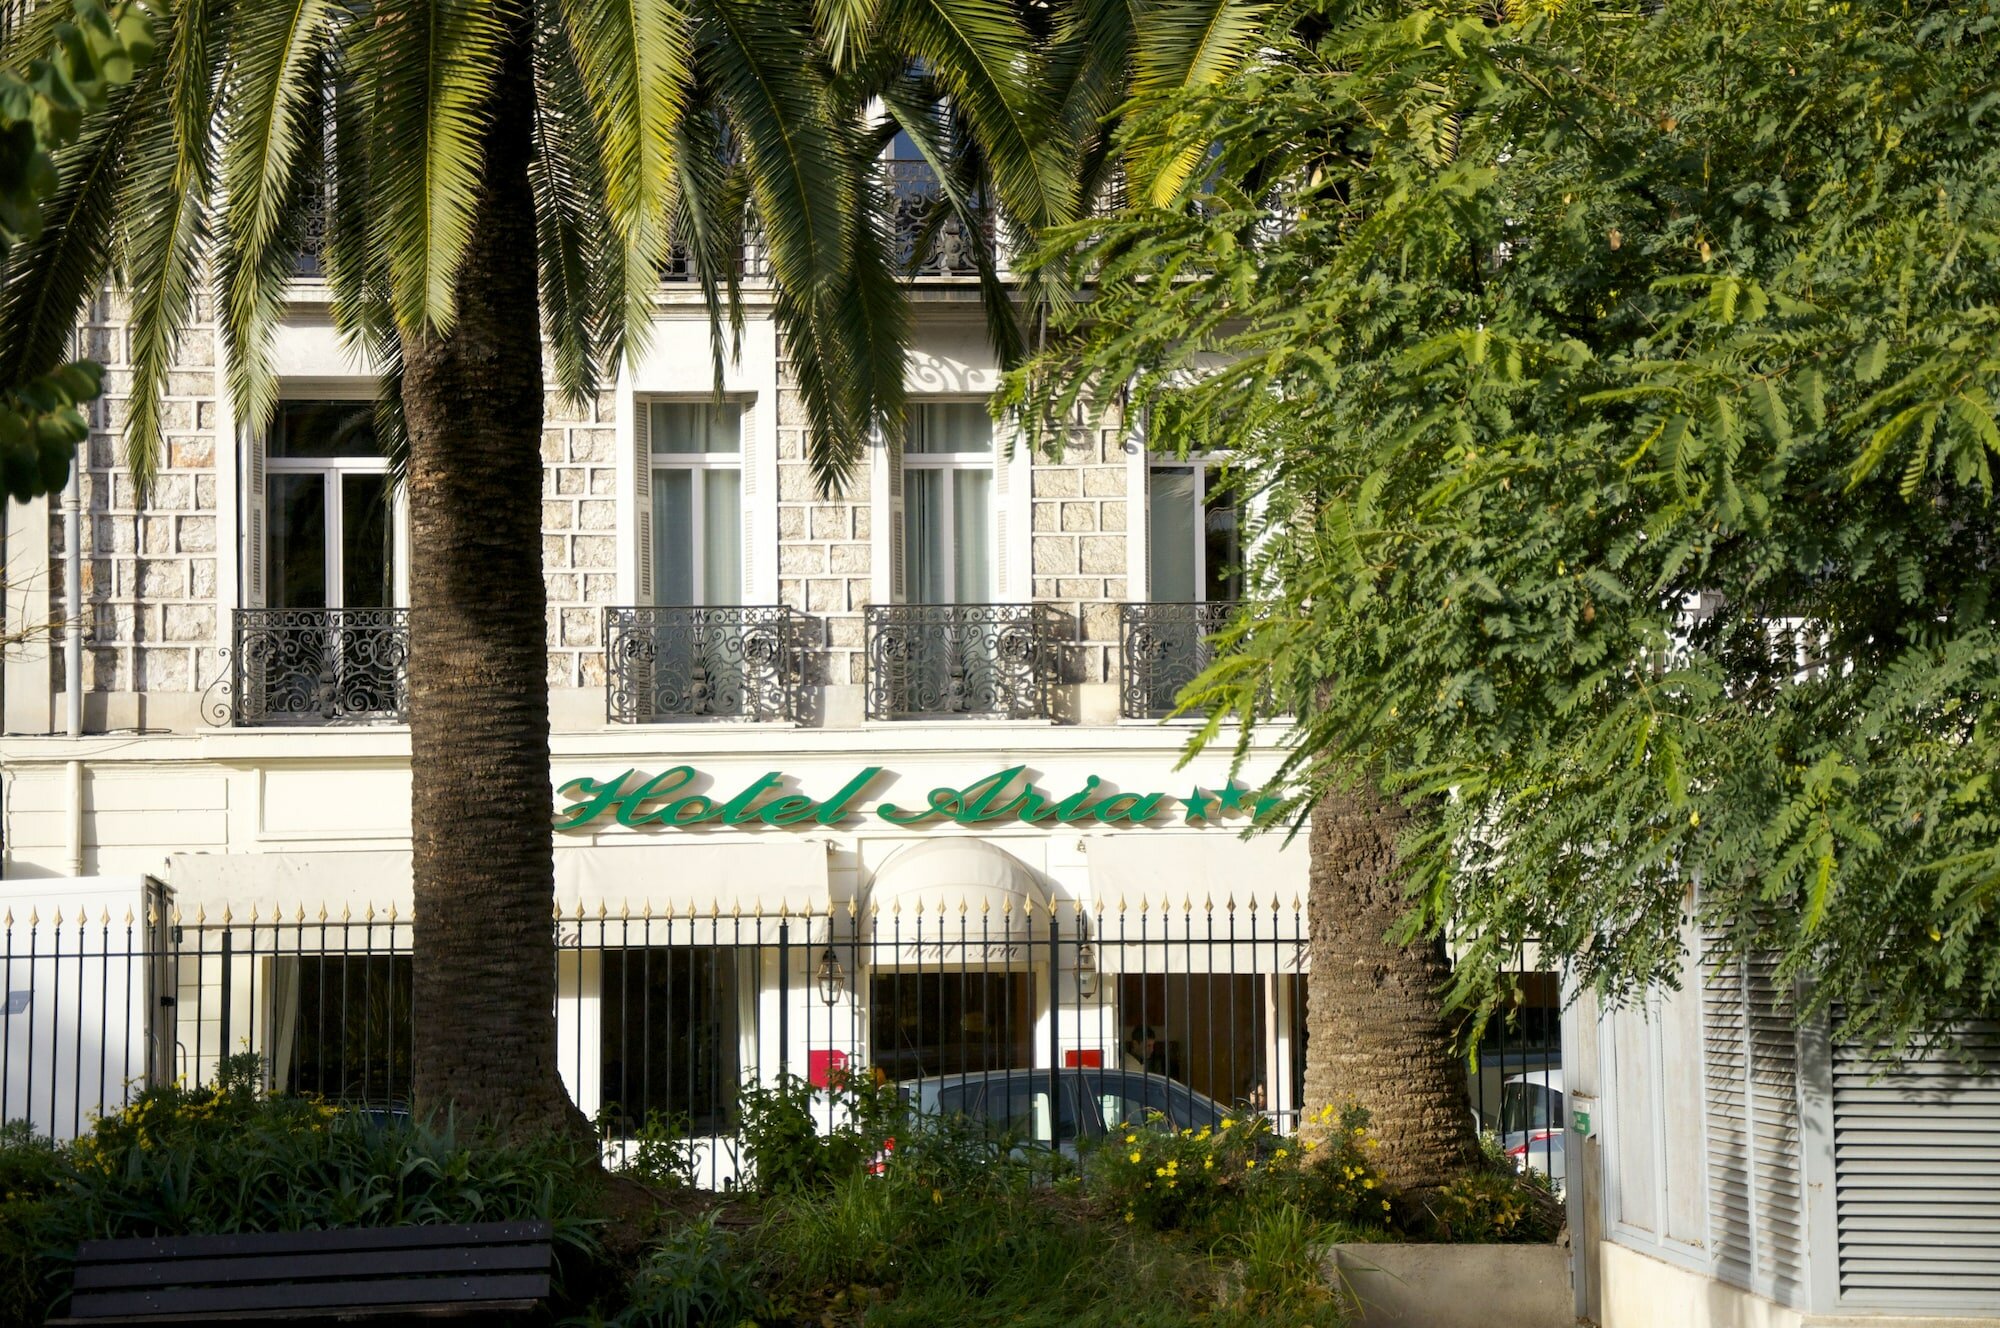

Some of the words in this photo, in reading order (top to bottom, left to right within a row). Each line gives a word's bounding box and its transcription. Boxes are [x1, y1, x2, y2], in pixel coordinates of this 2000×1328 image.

[553, 765, 883, 830] Hotel
[877, 764, 1166, 824] Aria
[903, 936, 962, 960] Hotel
